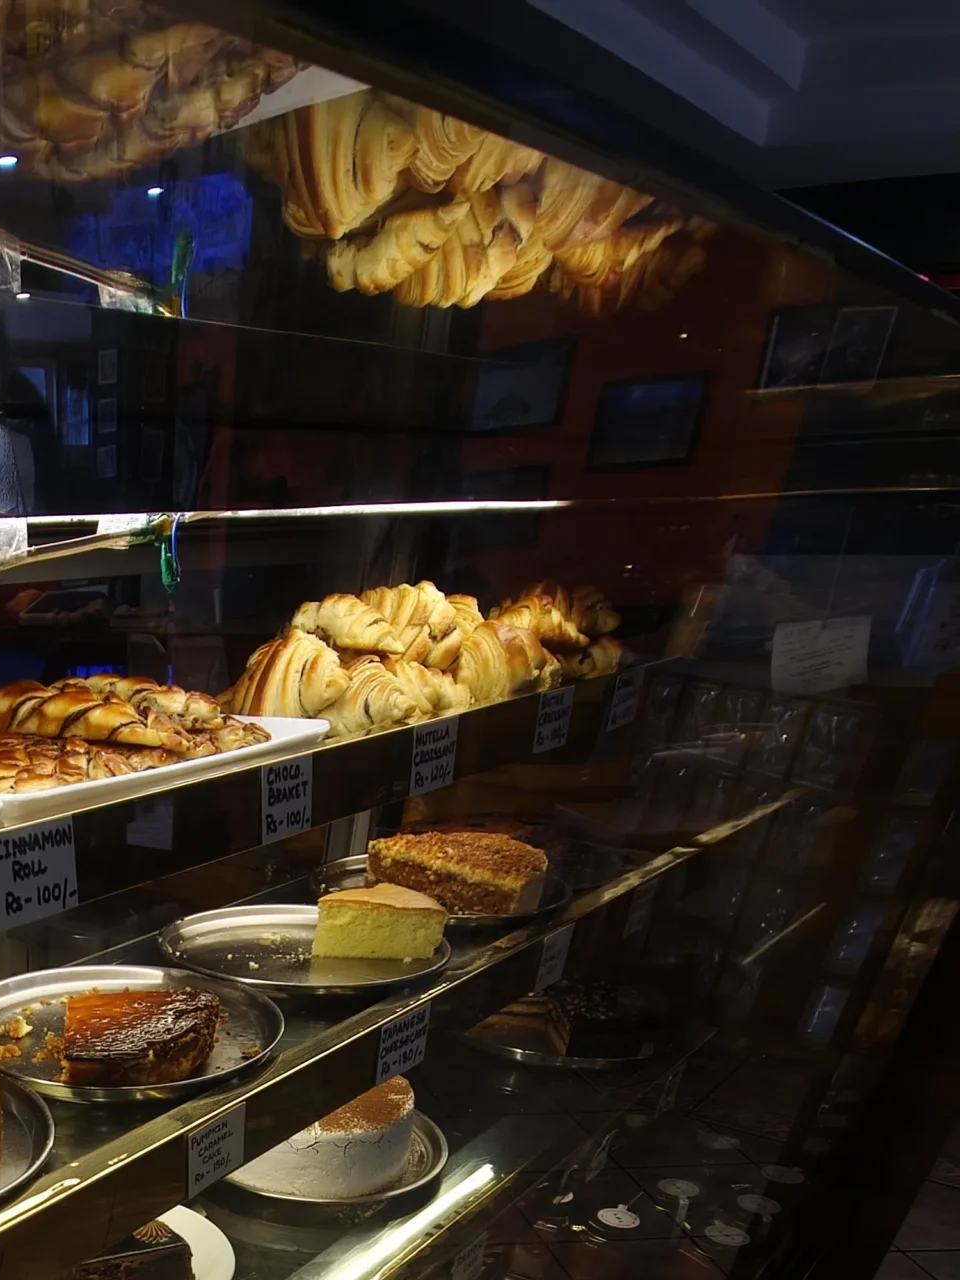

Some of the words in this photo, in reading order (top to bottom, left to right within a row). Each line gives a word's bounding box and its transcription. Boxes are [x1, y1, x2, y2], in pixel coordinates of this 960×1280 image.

[415, 724, 450, 749] NUTELLA
[413, 741, 456, 767] CROISSANT
[267, 781, 308, 807] BRAKET
[12, 860, 47, 883] ROLL
[382, 1010, 427, 1044] JAPANESE
[191, 1120, 228, 1150] PUMPKIN
[198, 1130, 233, 1157] CARAMEL
[202, 1147, 222, 1164] CAKE
